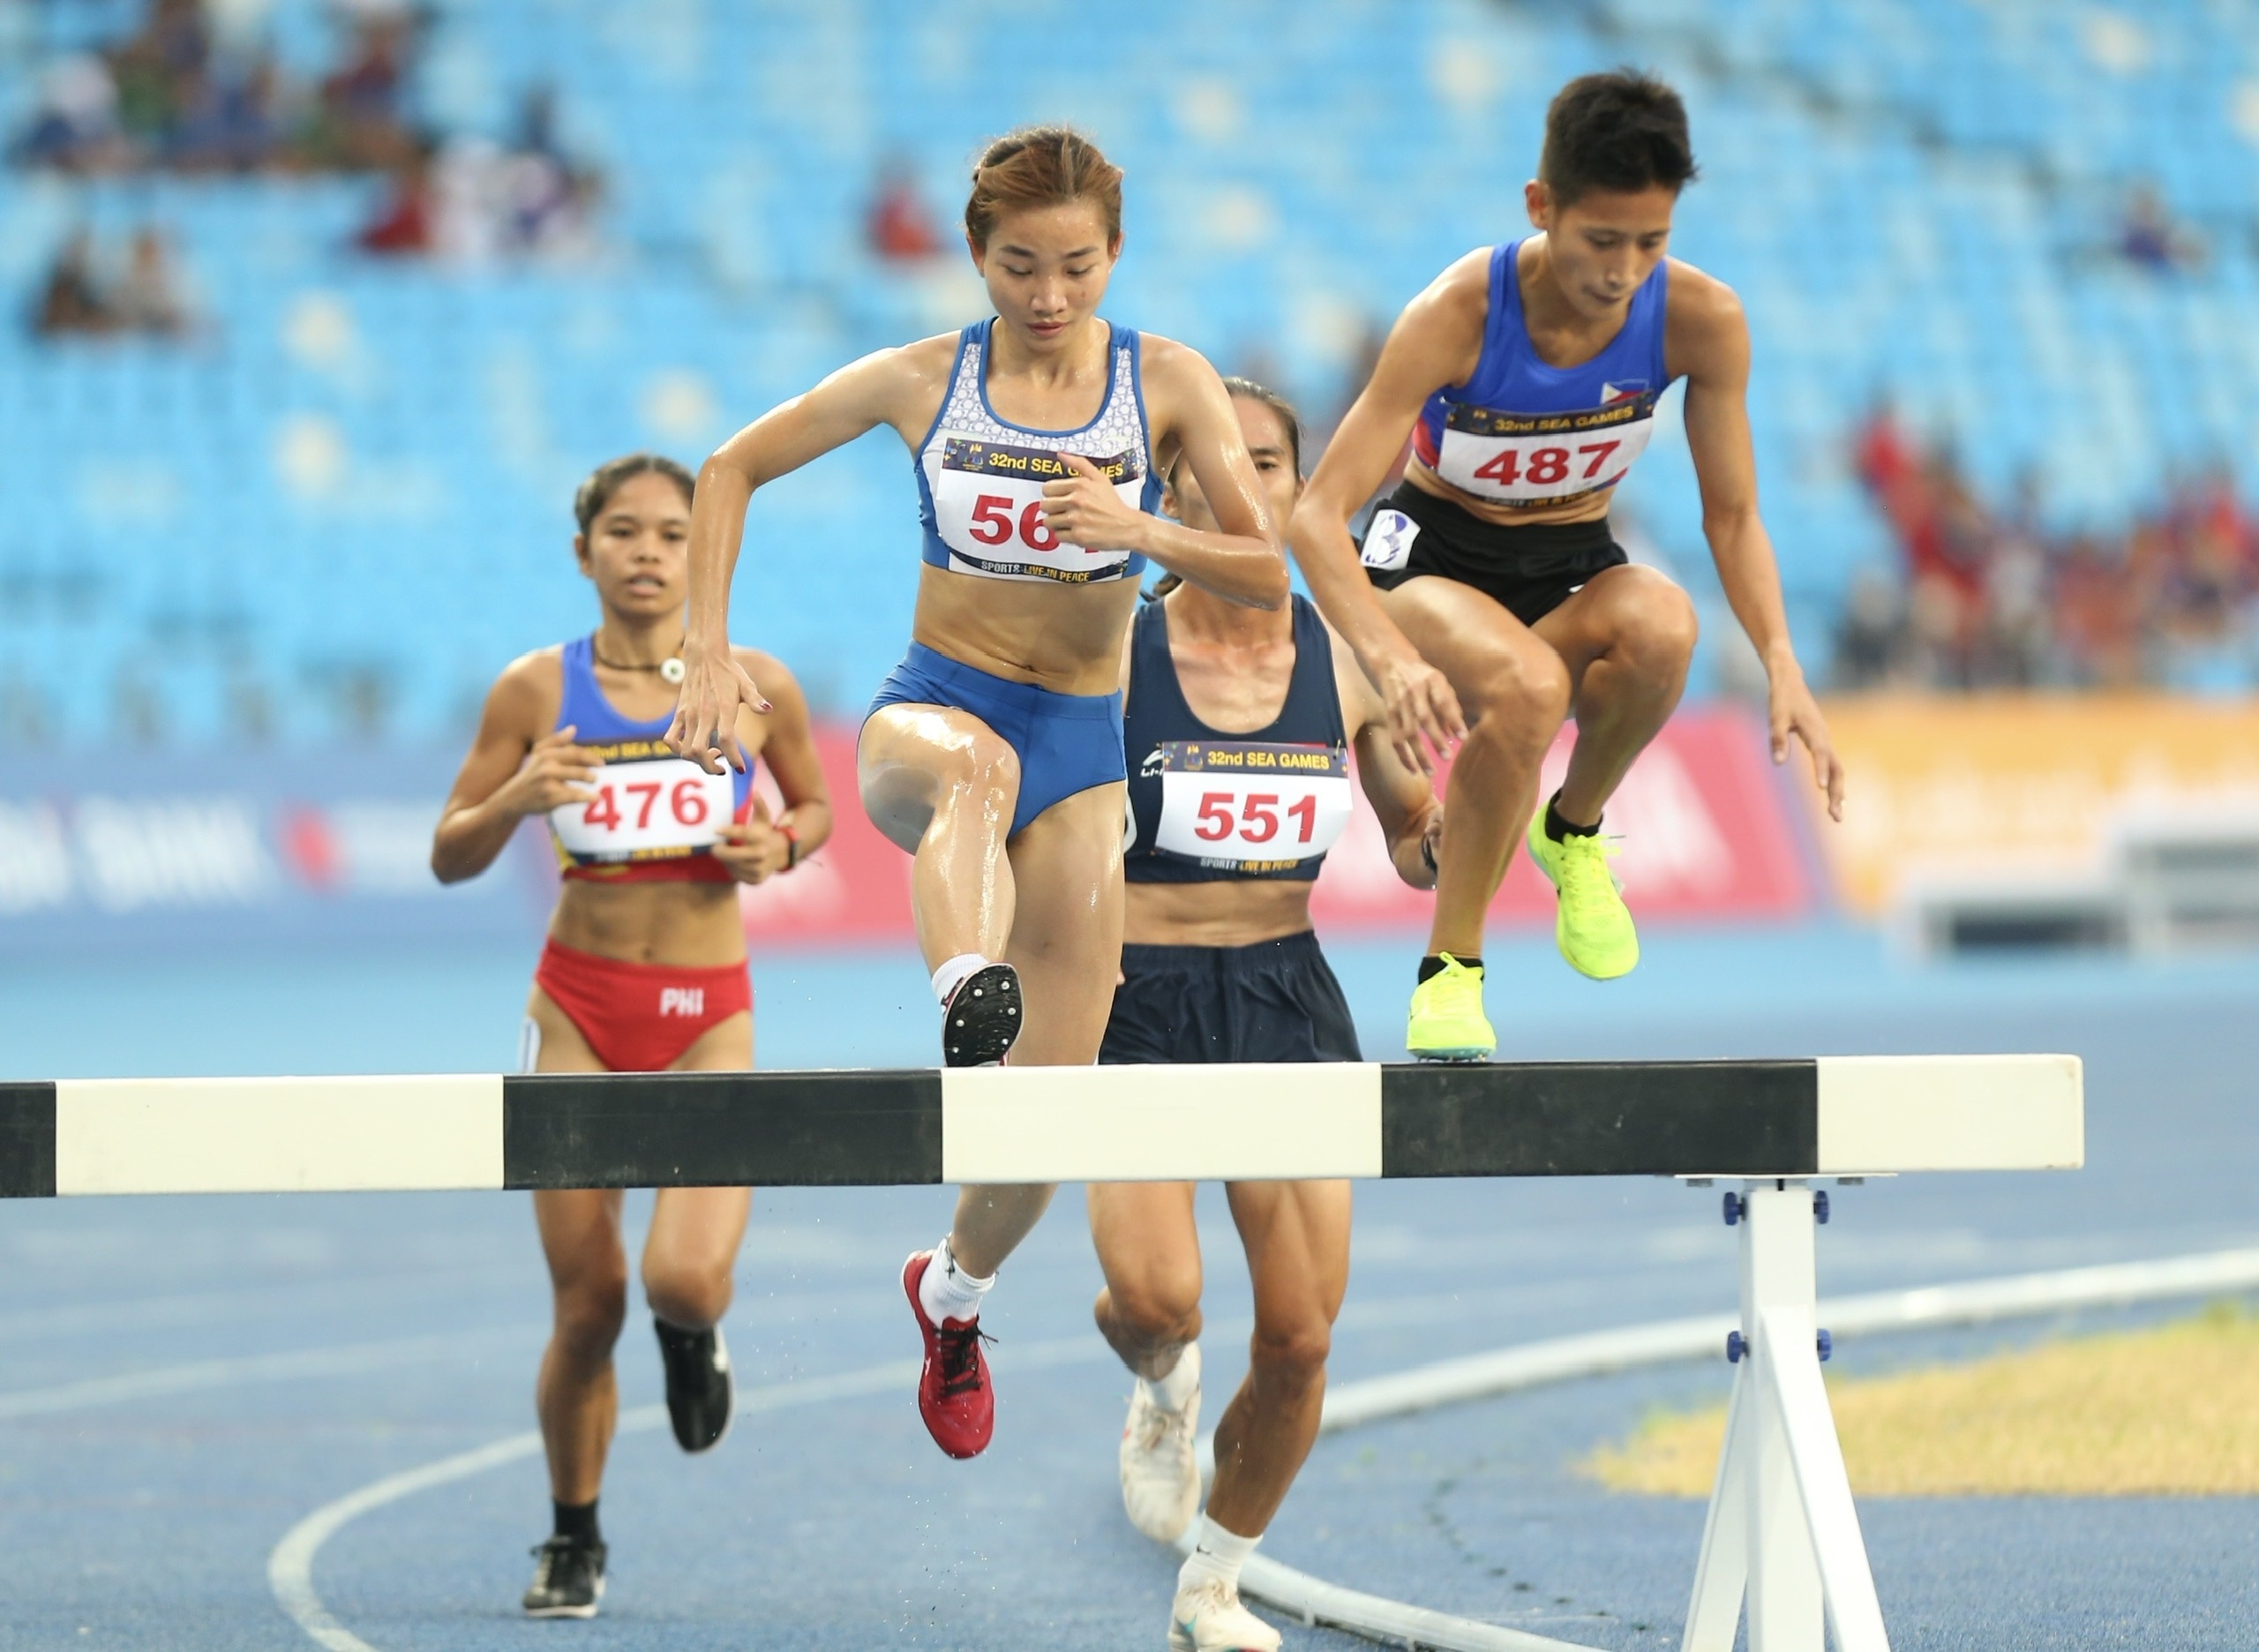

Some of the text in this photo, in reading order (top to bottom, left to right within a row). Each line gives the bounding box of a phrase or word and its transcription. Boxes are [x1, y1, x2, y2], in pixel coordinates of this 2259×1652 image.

[1495, 406, 1634, 432] 32nd SEA GAMES
[989, 453, 1027, 469] 32nd
[1031, 458, 1062, 475] SEA
[1068, 462, 1124, 480] GES
[1474, 439, 1622, 485] 487
[969, 494, 1099, 553] 56
[1024, 565, 1045, 576] LIVE
[1047, 567, 1057, 578] IN
[1060, 571, 1090, 582] PEACE
[1208, 751, 1329, 770] 32nd SEA GAMES
[582, 778, 709, 831] 476
[1195, 792, 1316, 843] 551
[659, 987, 704, 1017] PHI
